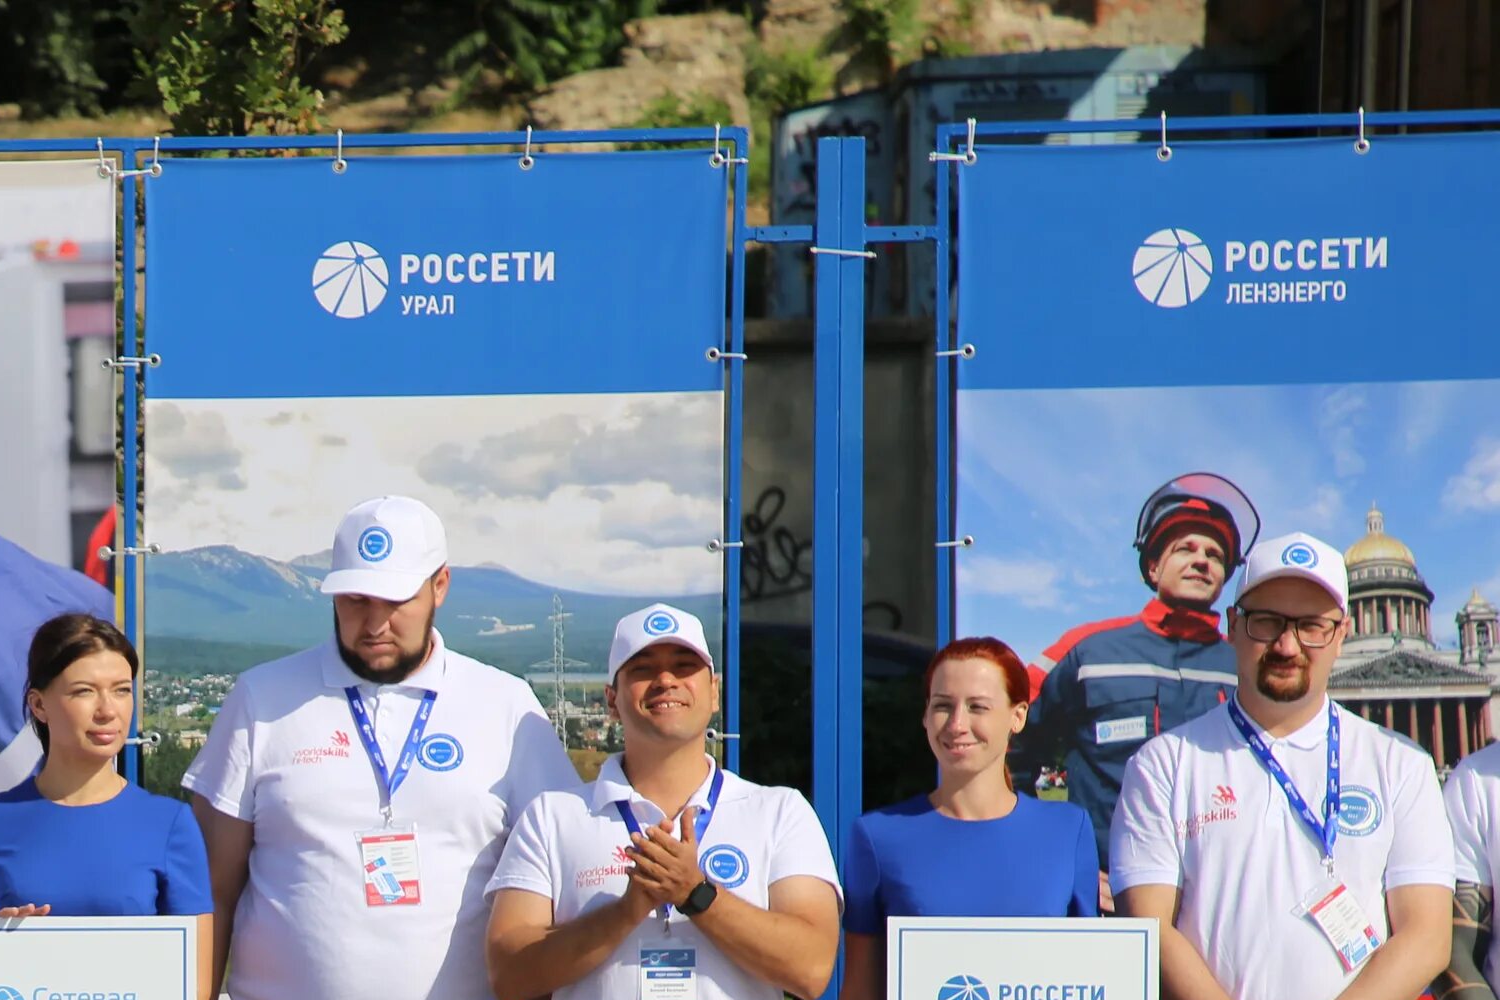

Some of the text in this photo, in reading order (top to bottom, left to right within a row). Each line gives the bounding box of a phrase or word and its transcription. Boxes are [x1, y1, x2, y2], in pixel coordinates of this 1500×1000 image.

[1225, 236, 1388, 272] РОССЕТИ
[400, 251, 555, 284] РОССЕТИ
[1226, 280, 1347, 304] ЛЕНЭНЕРГО
[401, 294, 455, 315] УРАЛ
[292, 747, 349, 759] worldskills
[576, 865, 628, 879] worldskill
